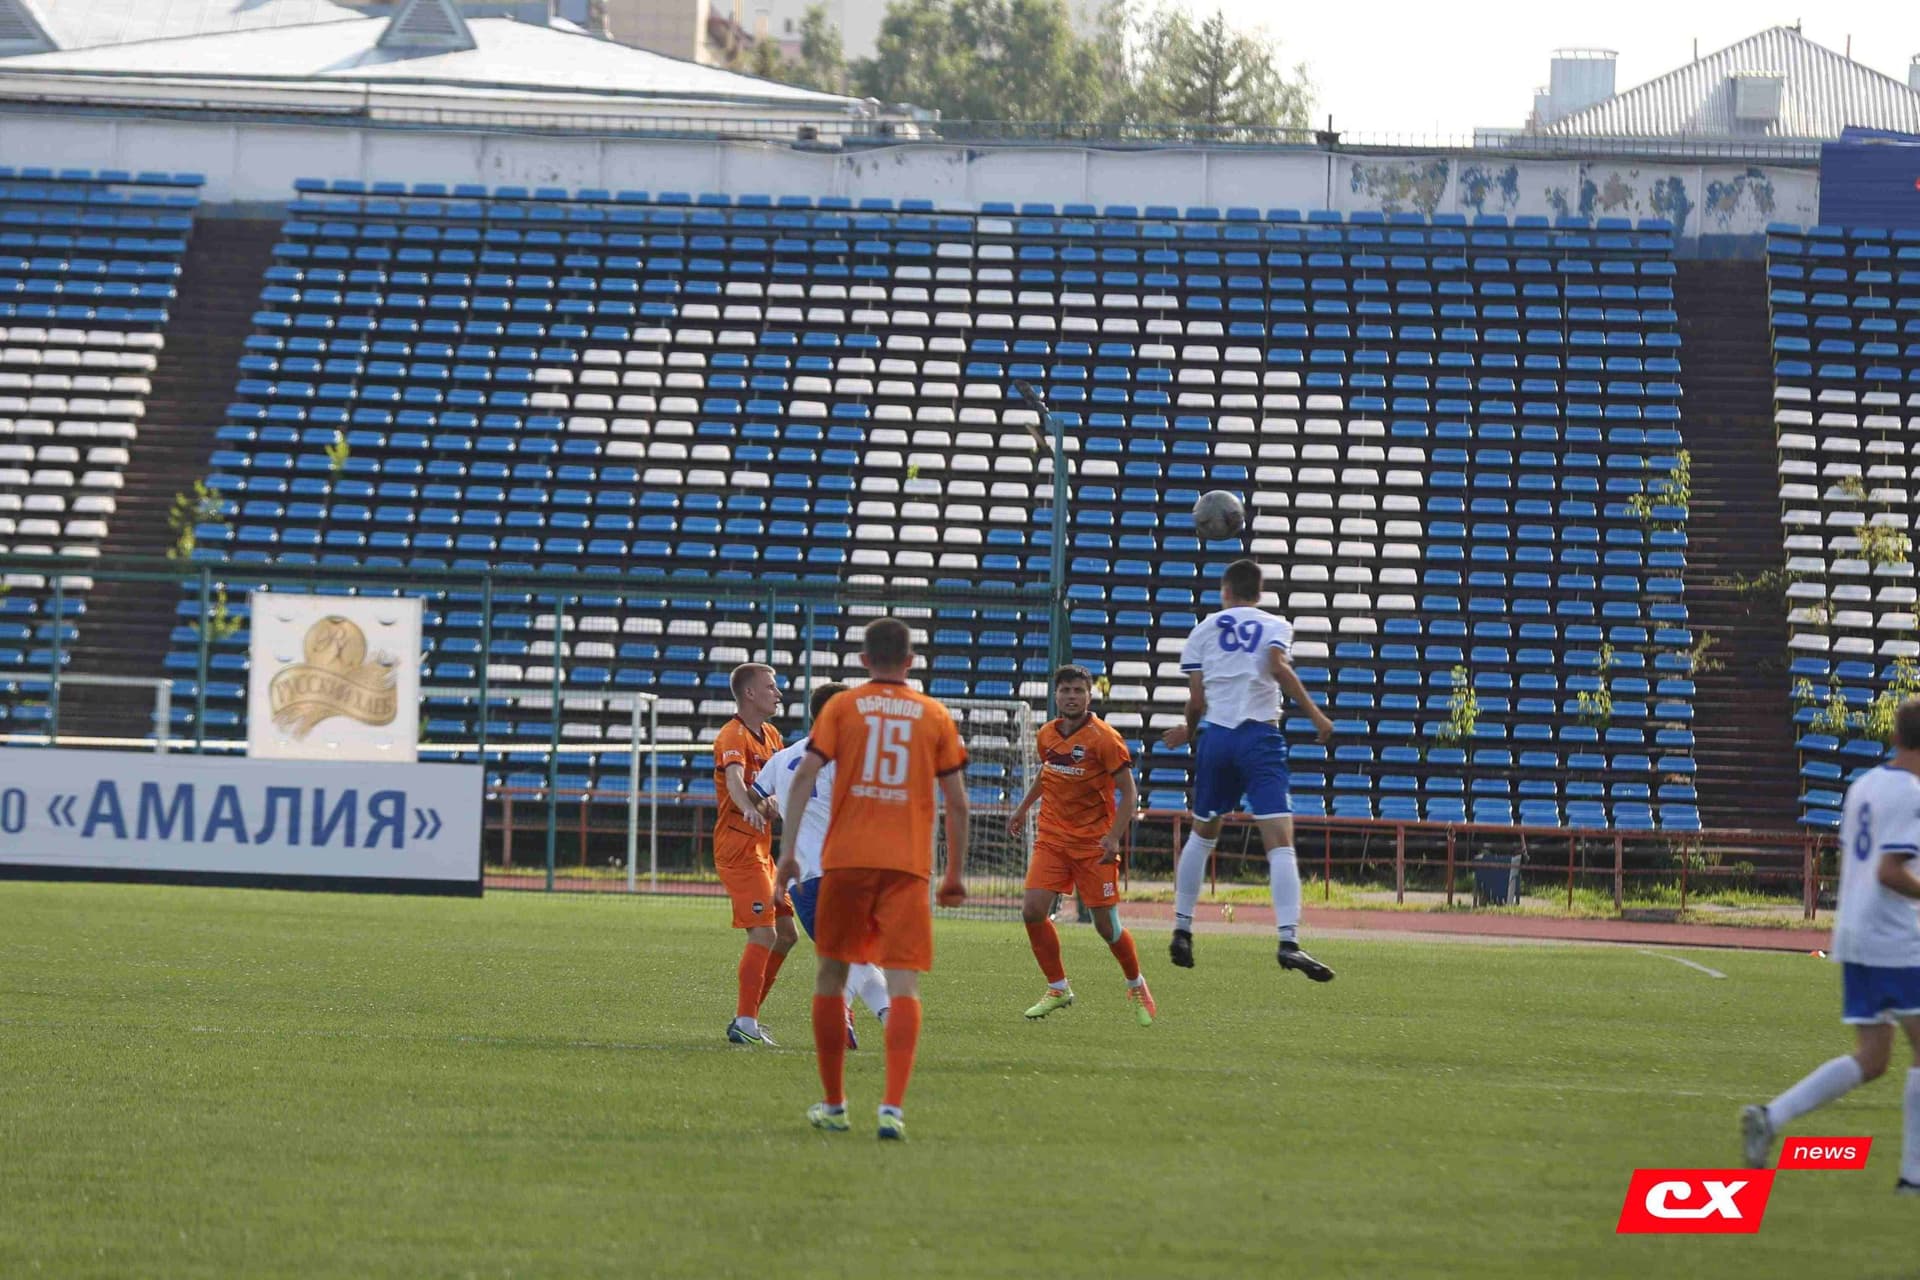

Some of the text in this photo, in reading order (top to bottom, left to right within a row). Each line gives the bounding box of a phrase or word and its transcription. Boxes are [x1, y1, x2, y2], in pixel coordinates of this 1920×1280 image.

[1215, 614, 1263, 653] 89
[862, 715, 912, 785] 15
[48, 779, 443, 849] «АМАЛИЯ»
